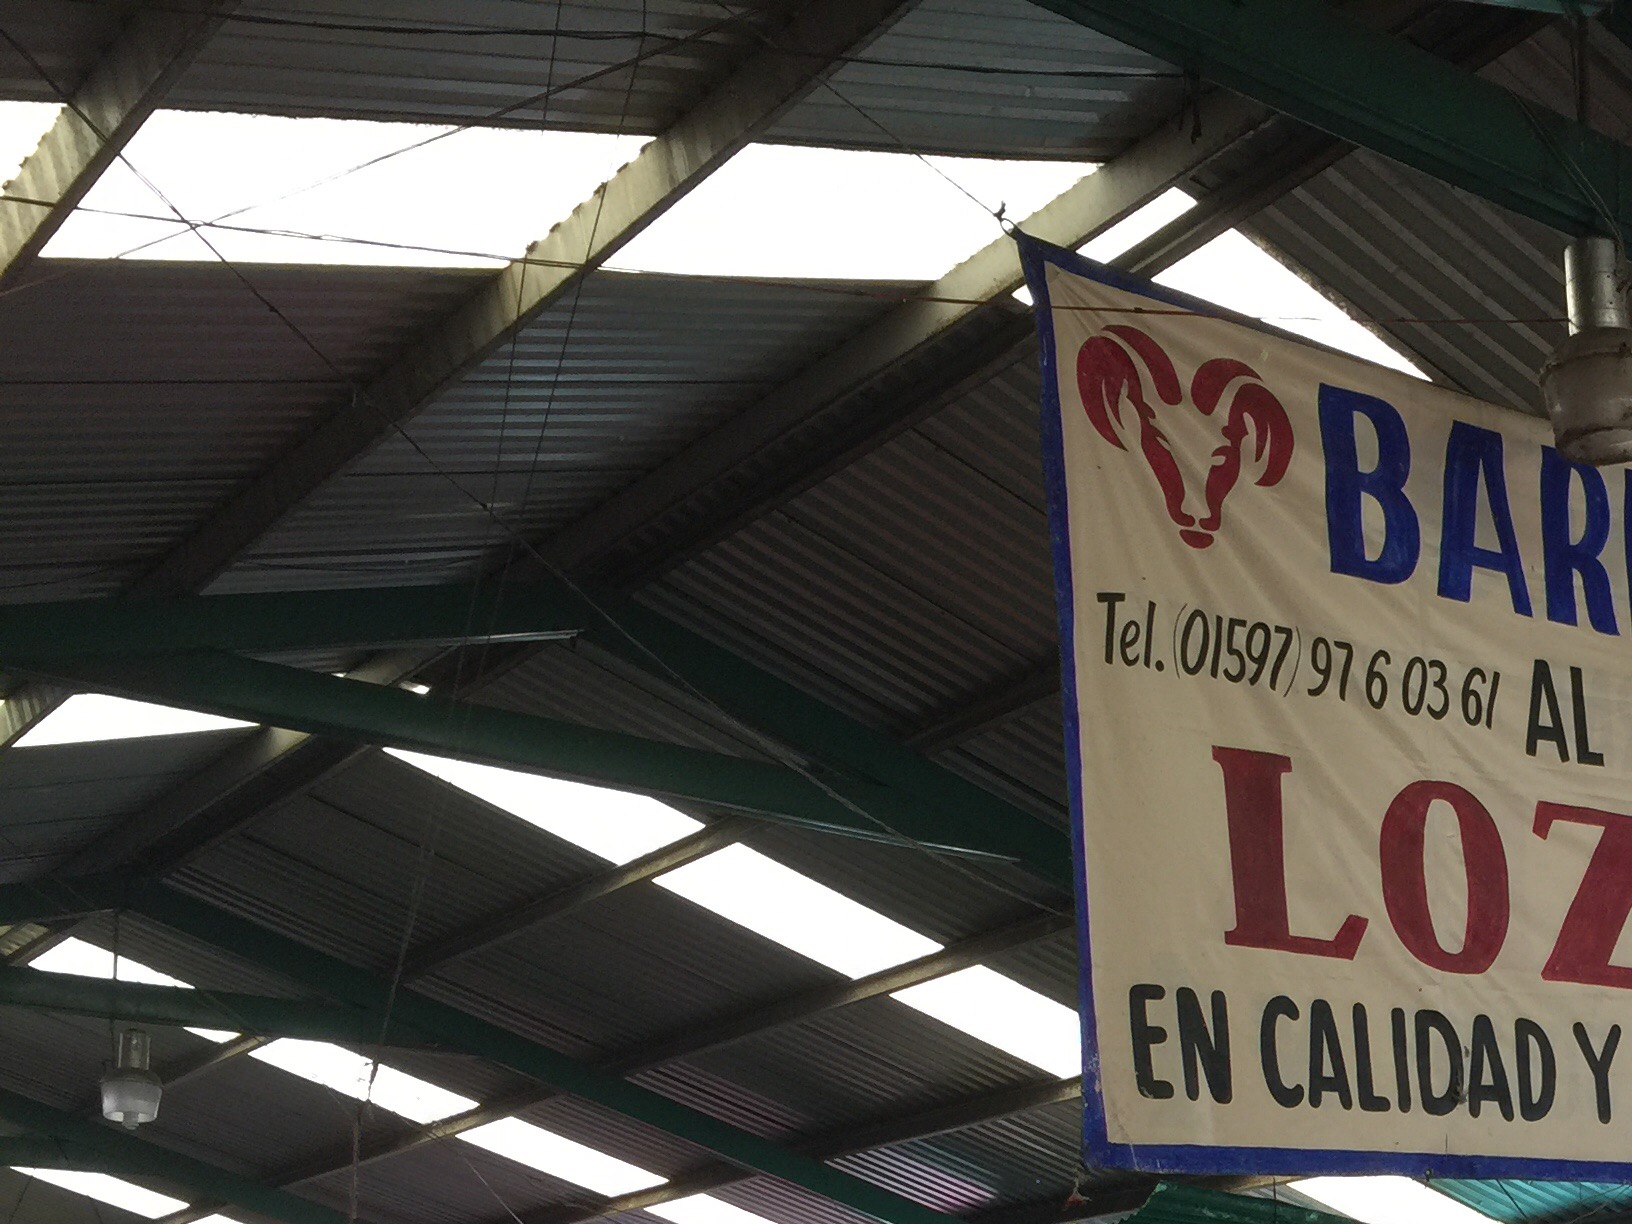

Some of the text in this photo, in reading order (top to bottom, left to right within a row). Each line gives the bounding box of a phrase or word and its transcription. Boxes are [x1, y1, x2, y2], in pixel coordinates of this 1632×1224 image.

[1097, 592, 1500, 730] Tel. (01597) 97 6 03 61
[1525, 659, 1605, 767] AL
[1129, 984, 1233, 1104] EN
[1261, 994, 1556, 1124] CALIDAD
[1573, 1021, 1622, 1124] Y
